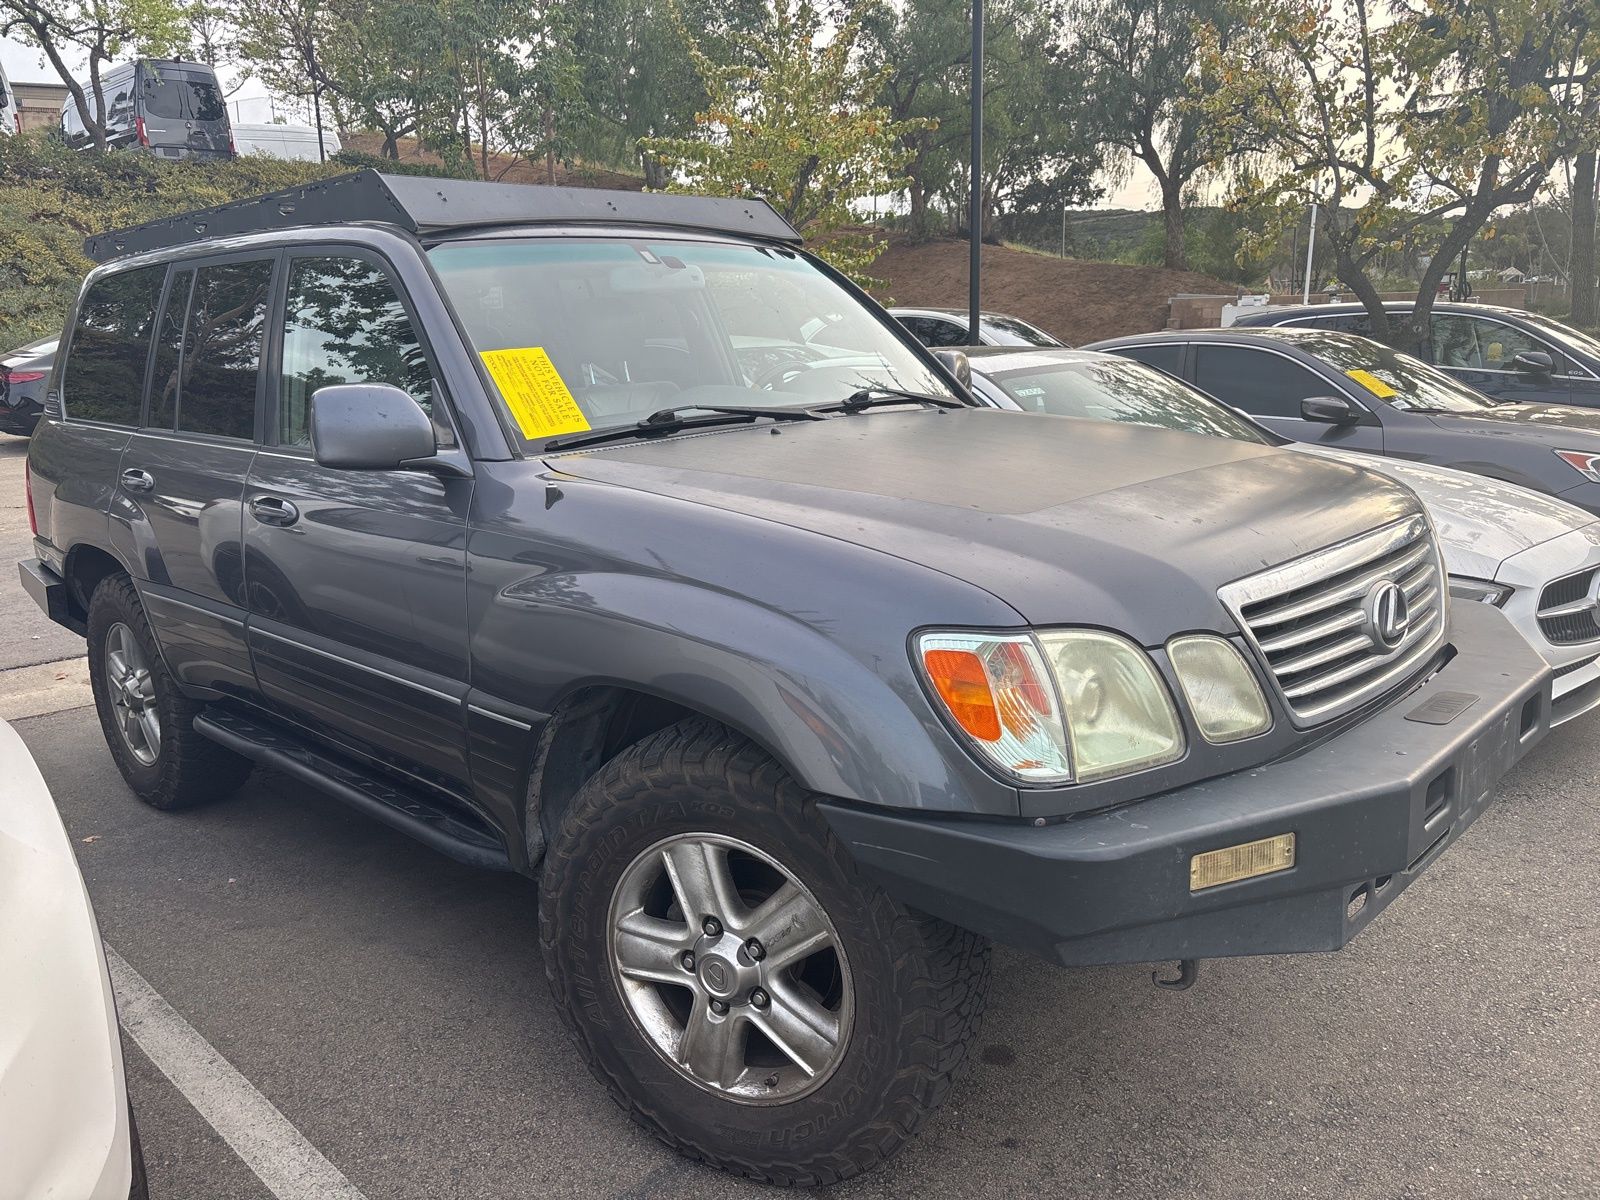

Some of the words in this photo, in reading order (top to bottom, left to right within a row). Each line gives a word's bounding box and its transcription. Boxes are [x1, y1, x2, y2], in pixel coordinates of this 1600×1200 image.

[531, 359, 545, 376] NOT
[542, 379, 557, 396] FOR
[553, 398, 571, 420] SALE
[537, 354, 552, 373] THIS
[549, 375, 576, 411] VEHICLE
[572, 413, 583, 423] IS
